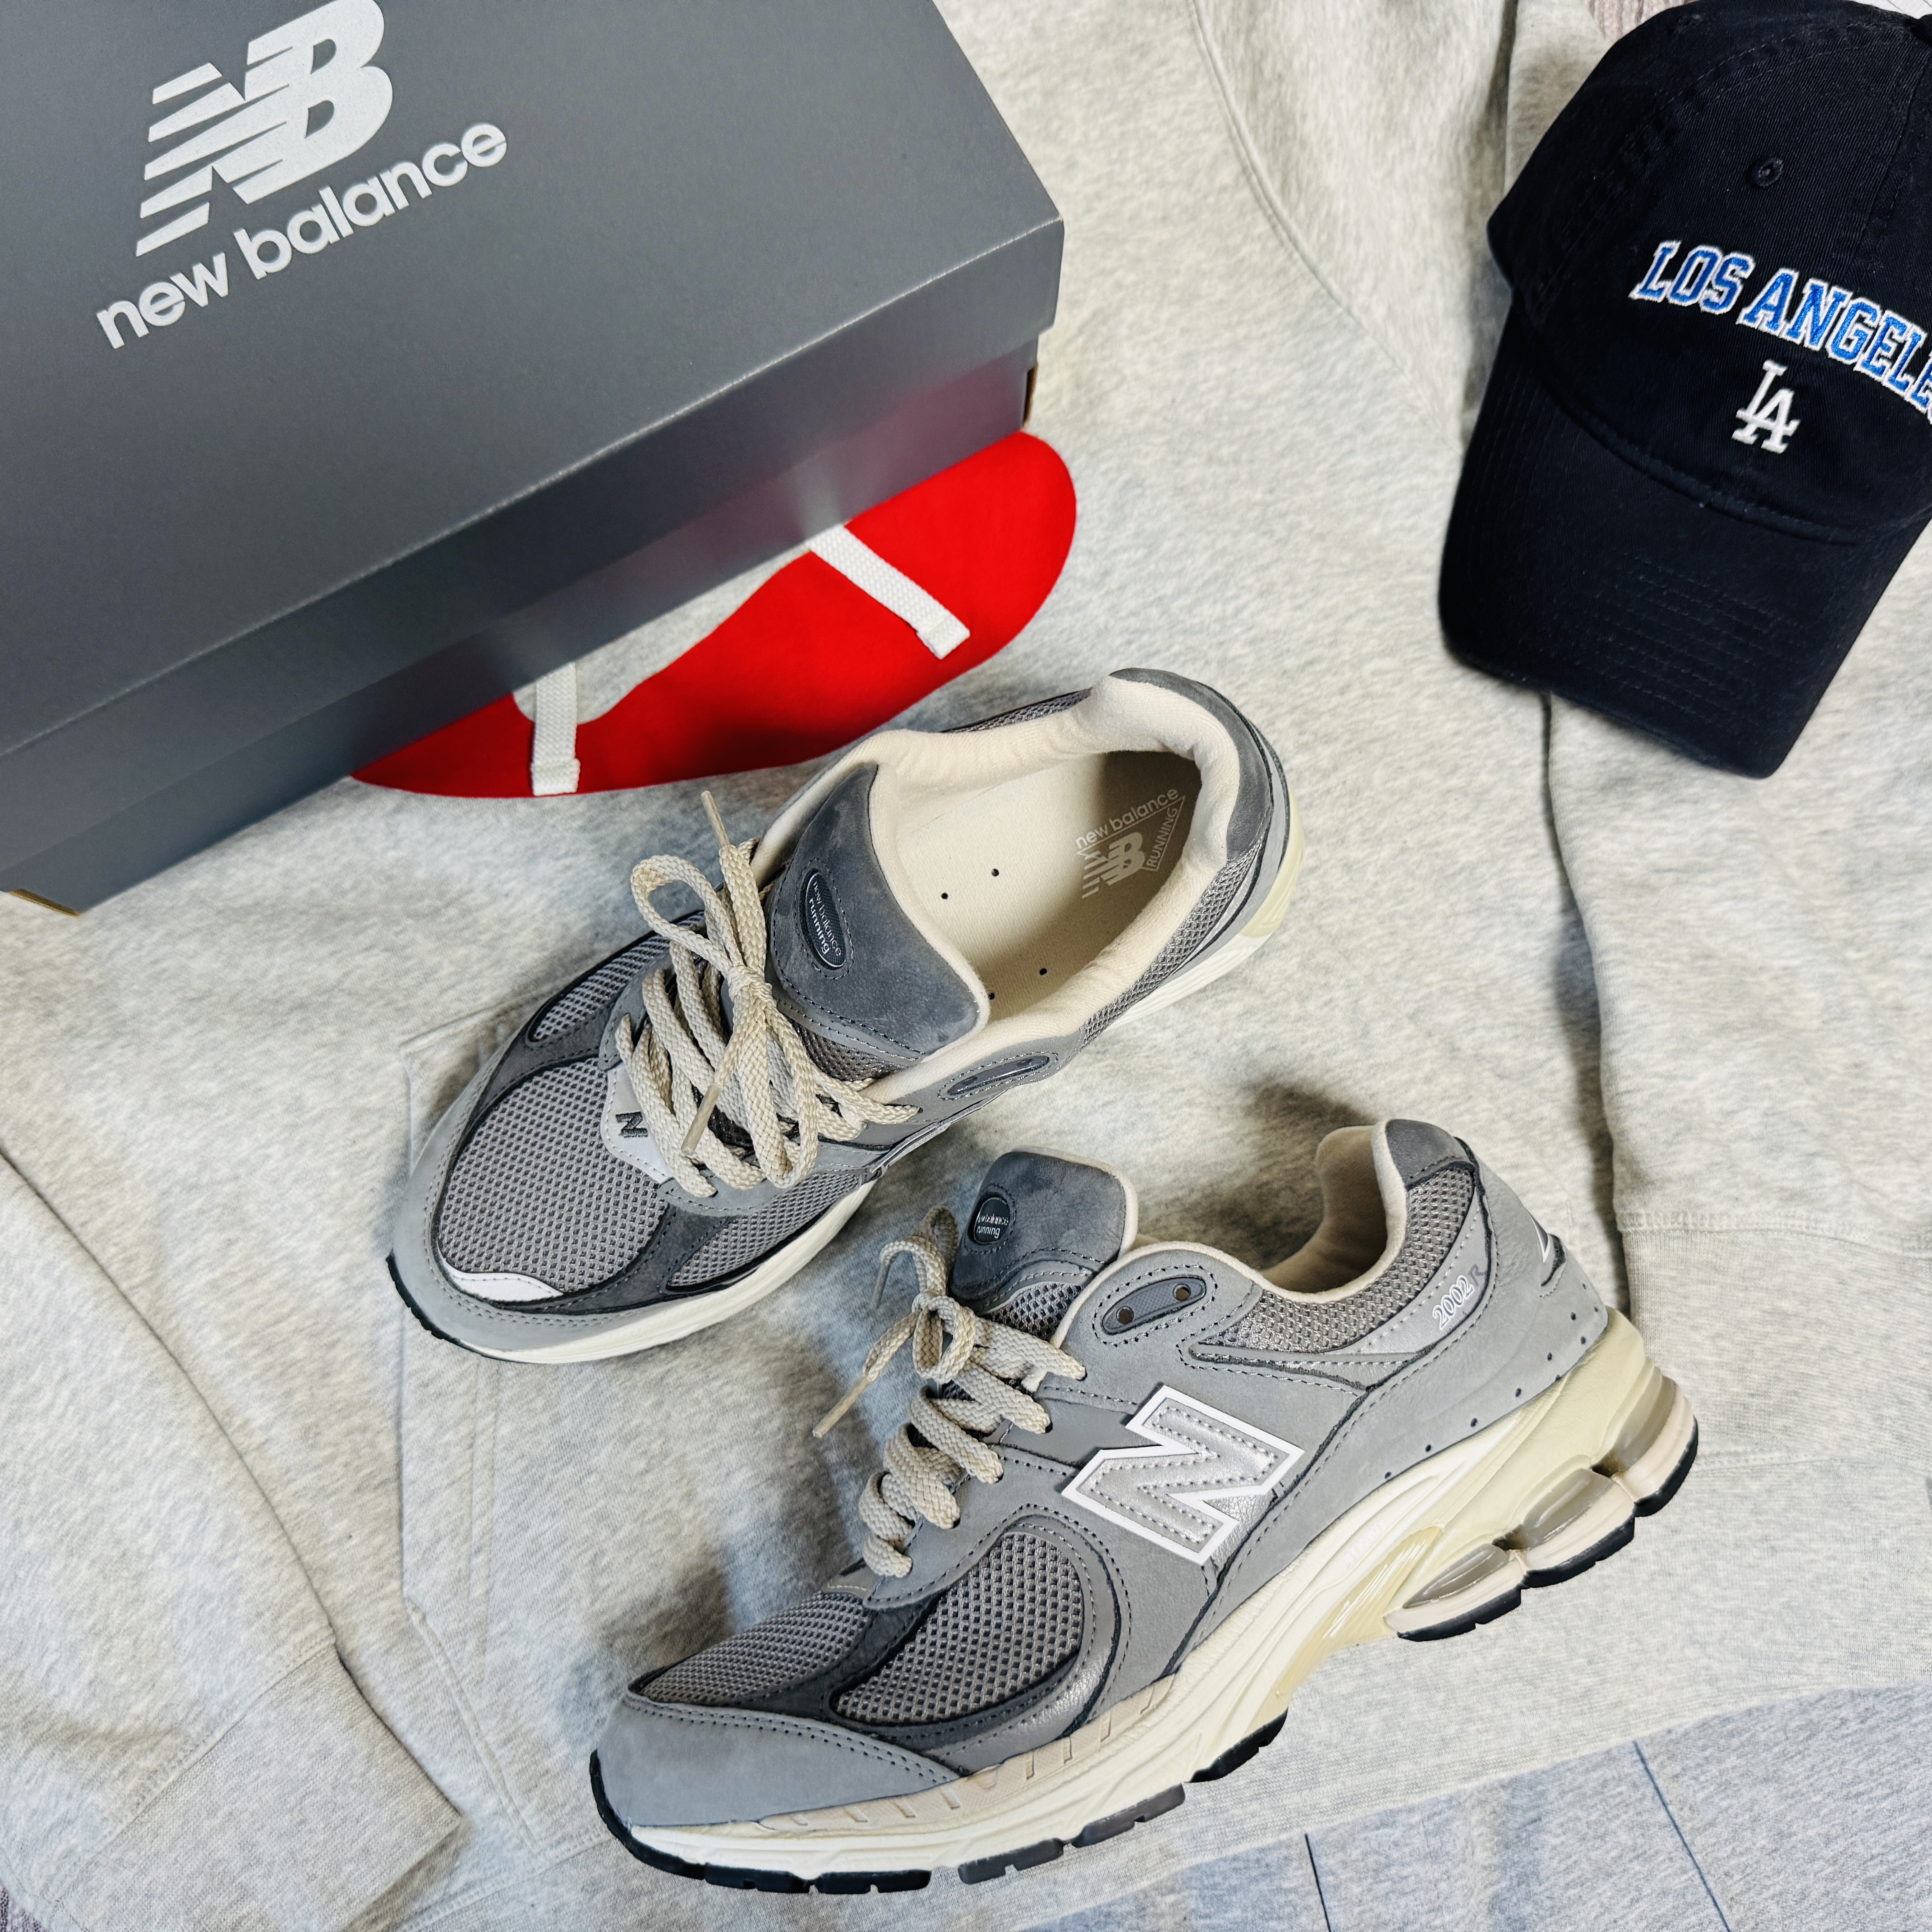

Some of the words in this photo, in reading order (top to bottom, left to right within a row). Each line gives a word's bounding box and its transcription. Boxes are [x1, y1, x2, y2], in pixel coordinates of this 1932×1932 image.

[96, 252, 229, 349] new
[233, 122, 507, 280] balance
[1628, 240, 1756, 315] LOS
[1735, 267, 1932, 424] ANGEL
[1731, 359, 1801, 454] LA
[1076, 824, 1109, 849] new
[1109, 789, 1178, 831] balance
[1146, 807, 1178, 868] RUNNING
[809, 897, 830, 955] running
[813, 881, 822, 904] new
[819, 904, 842, 957] balance
[976, 1225, 1001, 1239] running
[1061, 1385, 1306, 1565] N
